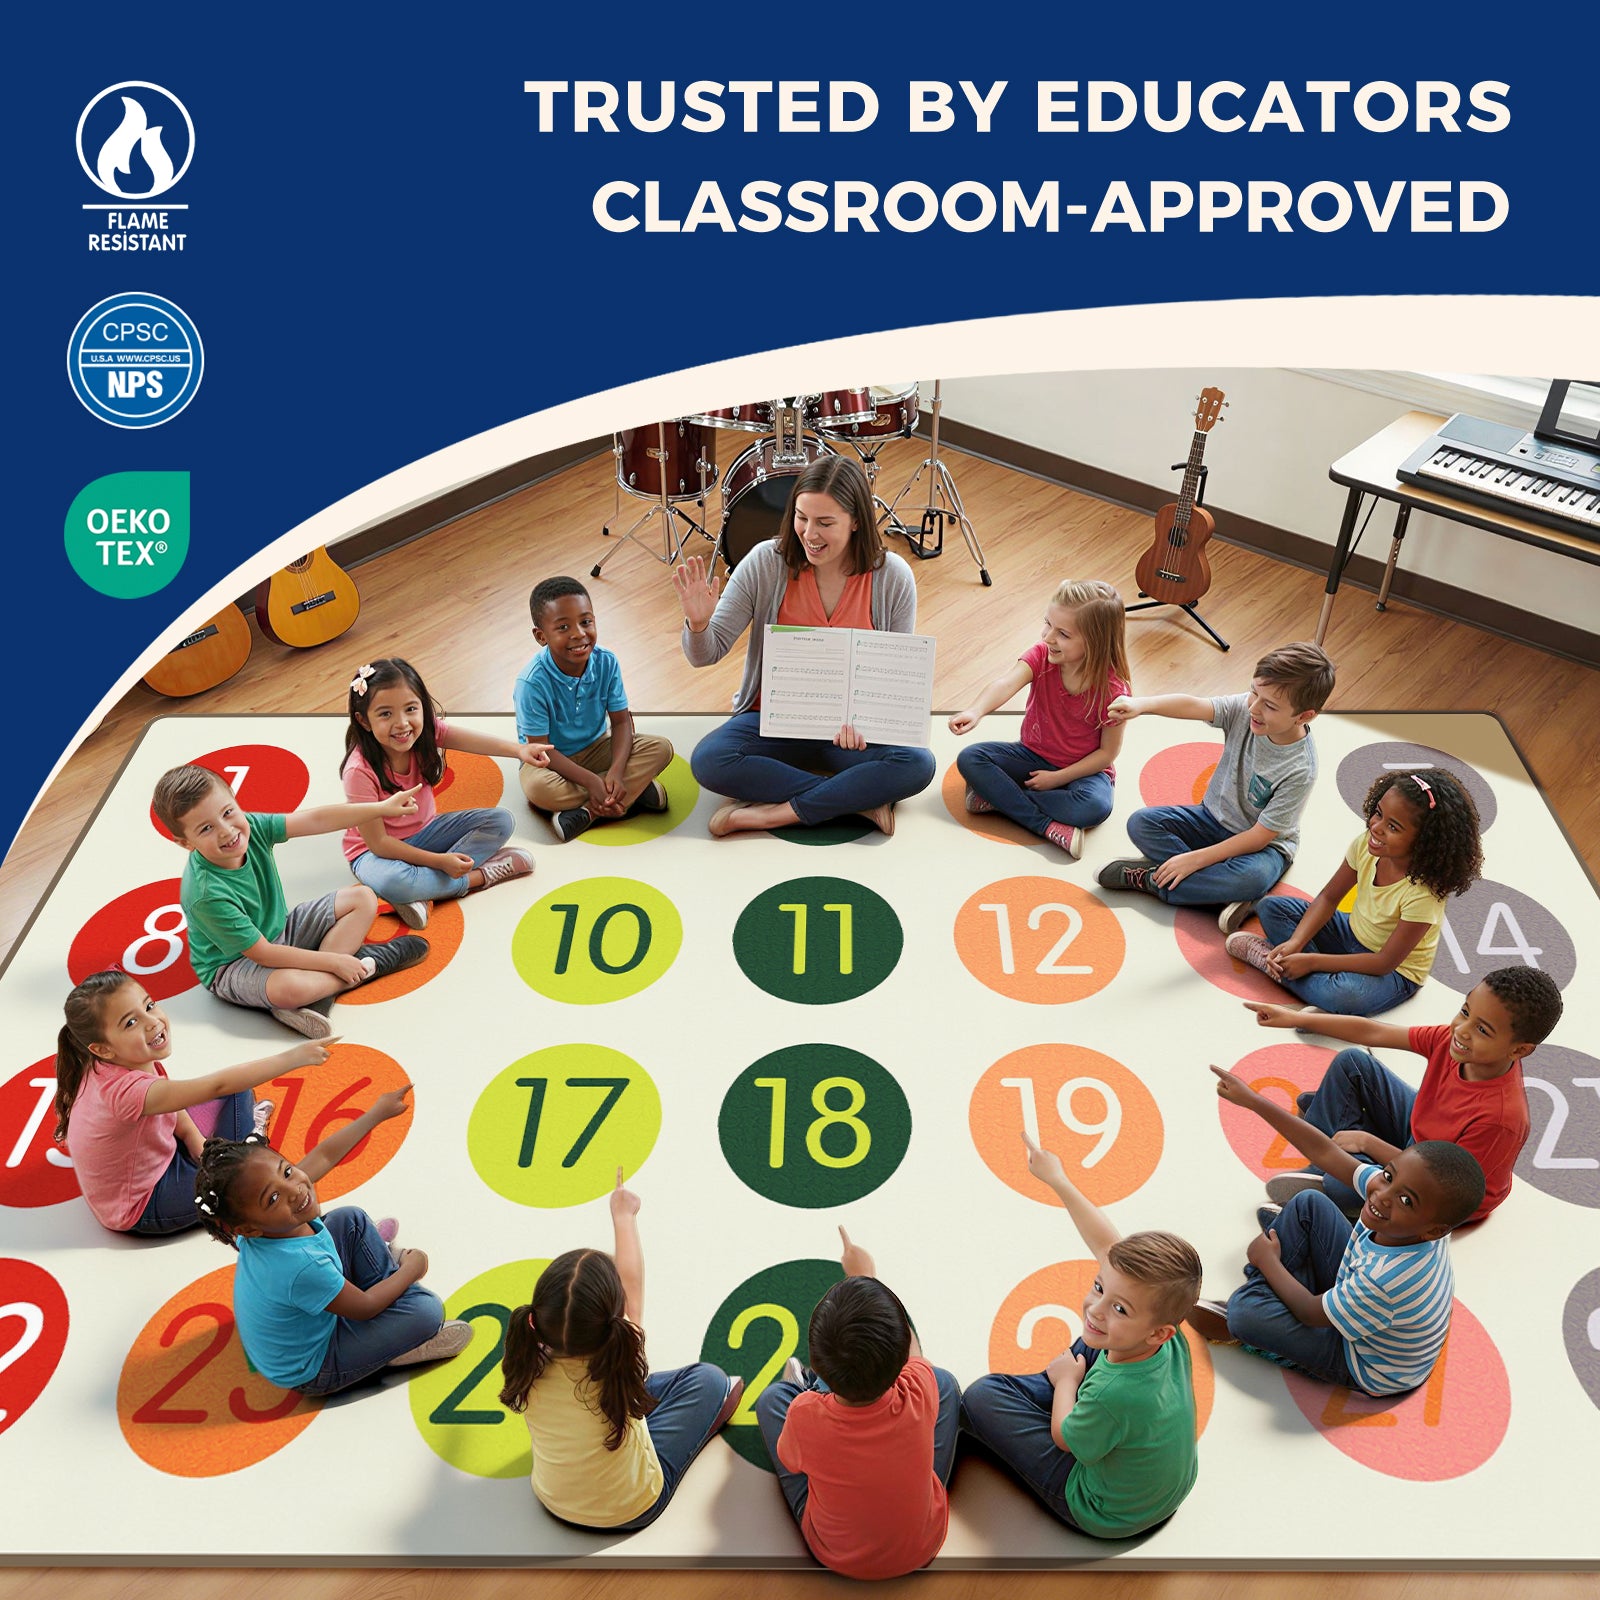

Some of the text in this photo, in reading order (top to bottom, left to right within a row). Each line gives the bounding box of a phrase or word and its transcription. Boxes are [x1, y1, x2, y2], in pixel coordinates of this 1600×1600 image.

[122, 903, 188, 975] 8
[549, 903, 653, 975] 10
[778, 903, 853, 975] 11
[978, 903, 1094, 975] 12
[5, 1077, 75, 1169] 1
[268, 1077, 374, 1167] 16
[514, 1077, 631, 1169] 17
[753, 1077, 872, 1169] 18
[1001, 1077, 1123, 1169] 19
